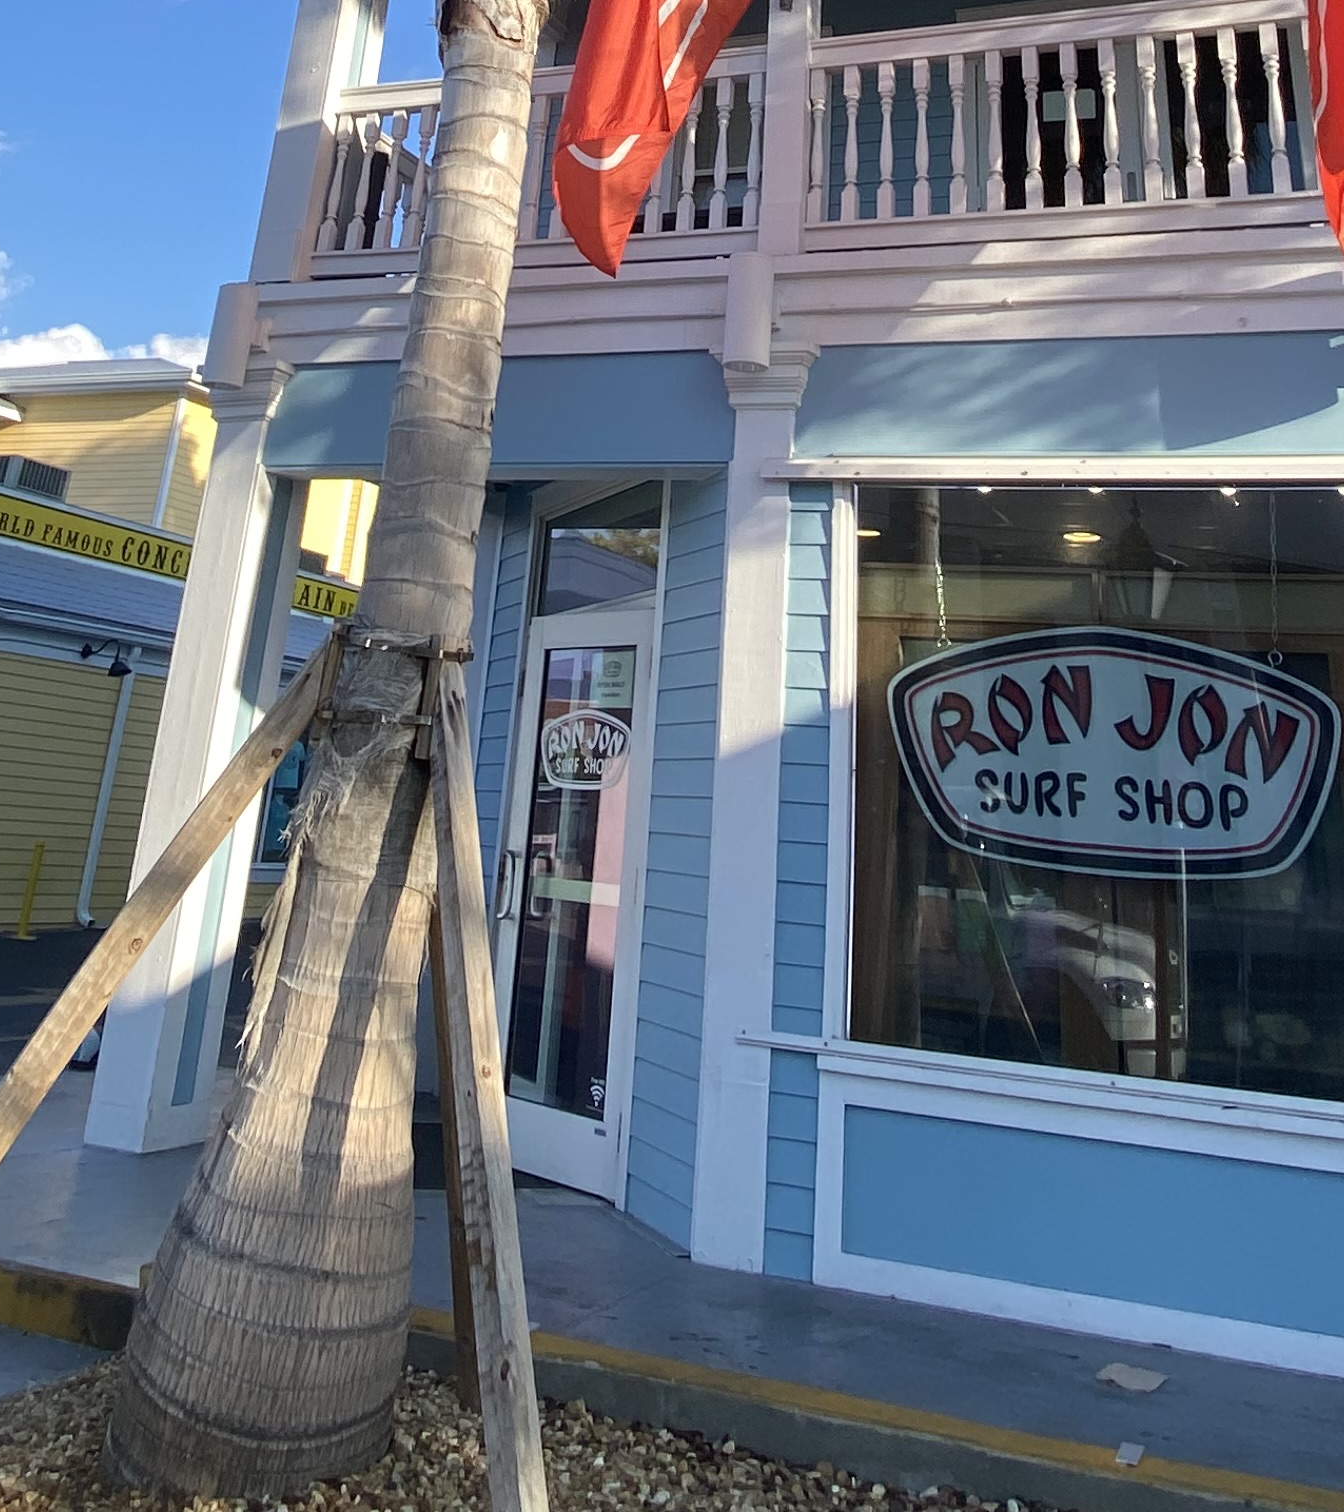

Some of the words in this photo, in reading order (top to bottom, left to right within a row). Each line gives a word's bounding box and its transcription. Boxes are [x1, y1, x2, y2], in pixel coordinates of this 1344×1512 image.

[41, 523, 115, 557] FAMOUS
[297, 583, 337, 612] AIN
[548, 719, 585, 760] RON
[588, 723, 625, 758] JON
[930, 664, 1093, 772] RON
[1113, 671, 1301, 784] JON
[556, 757, 580, 774] SURF
[974, 768, 1088, 818] SURF
[1115, 775, 1249, 831] SHOP
